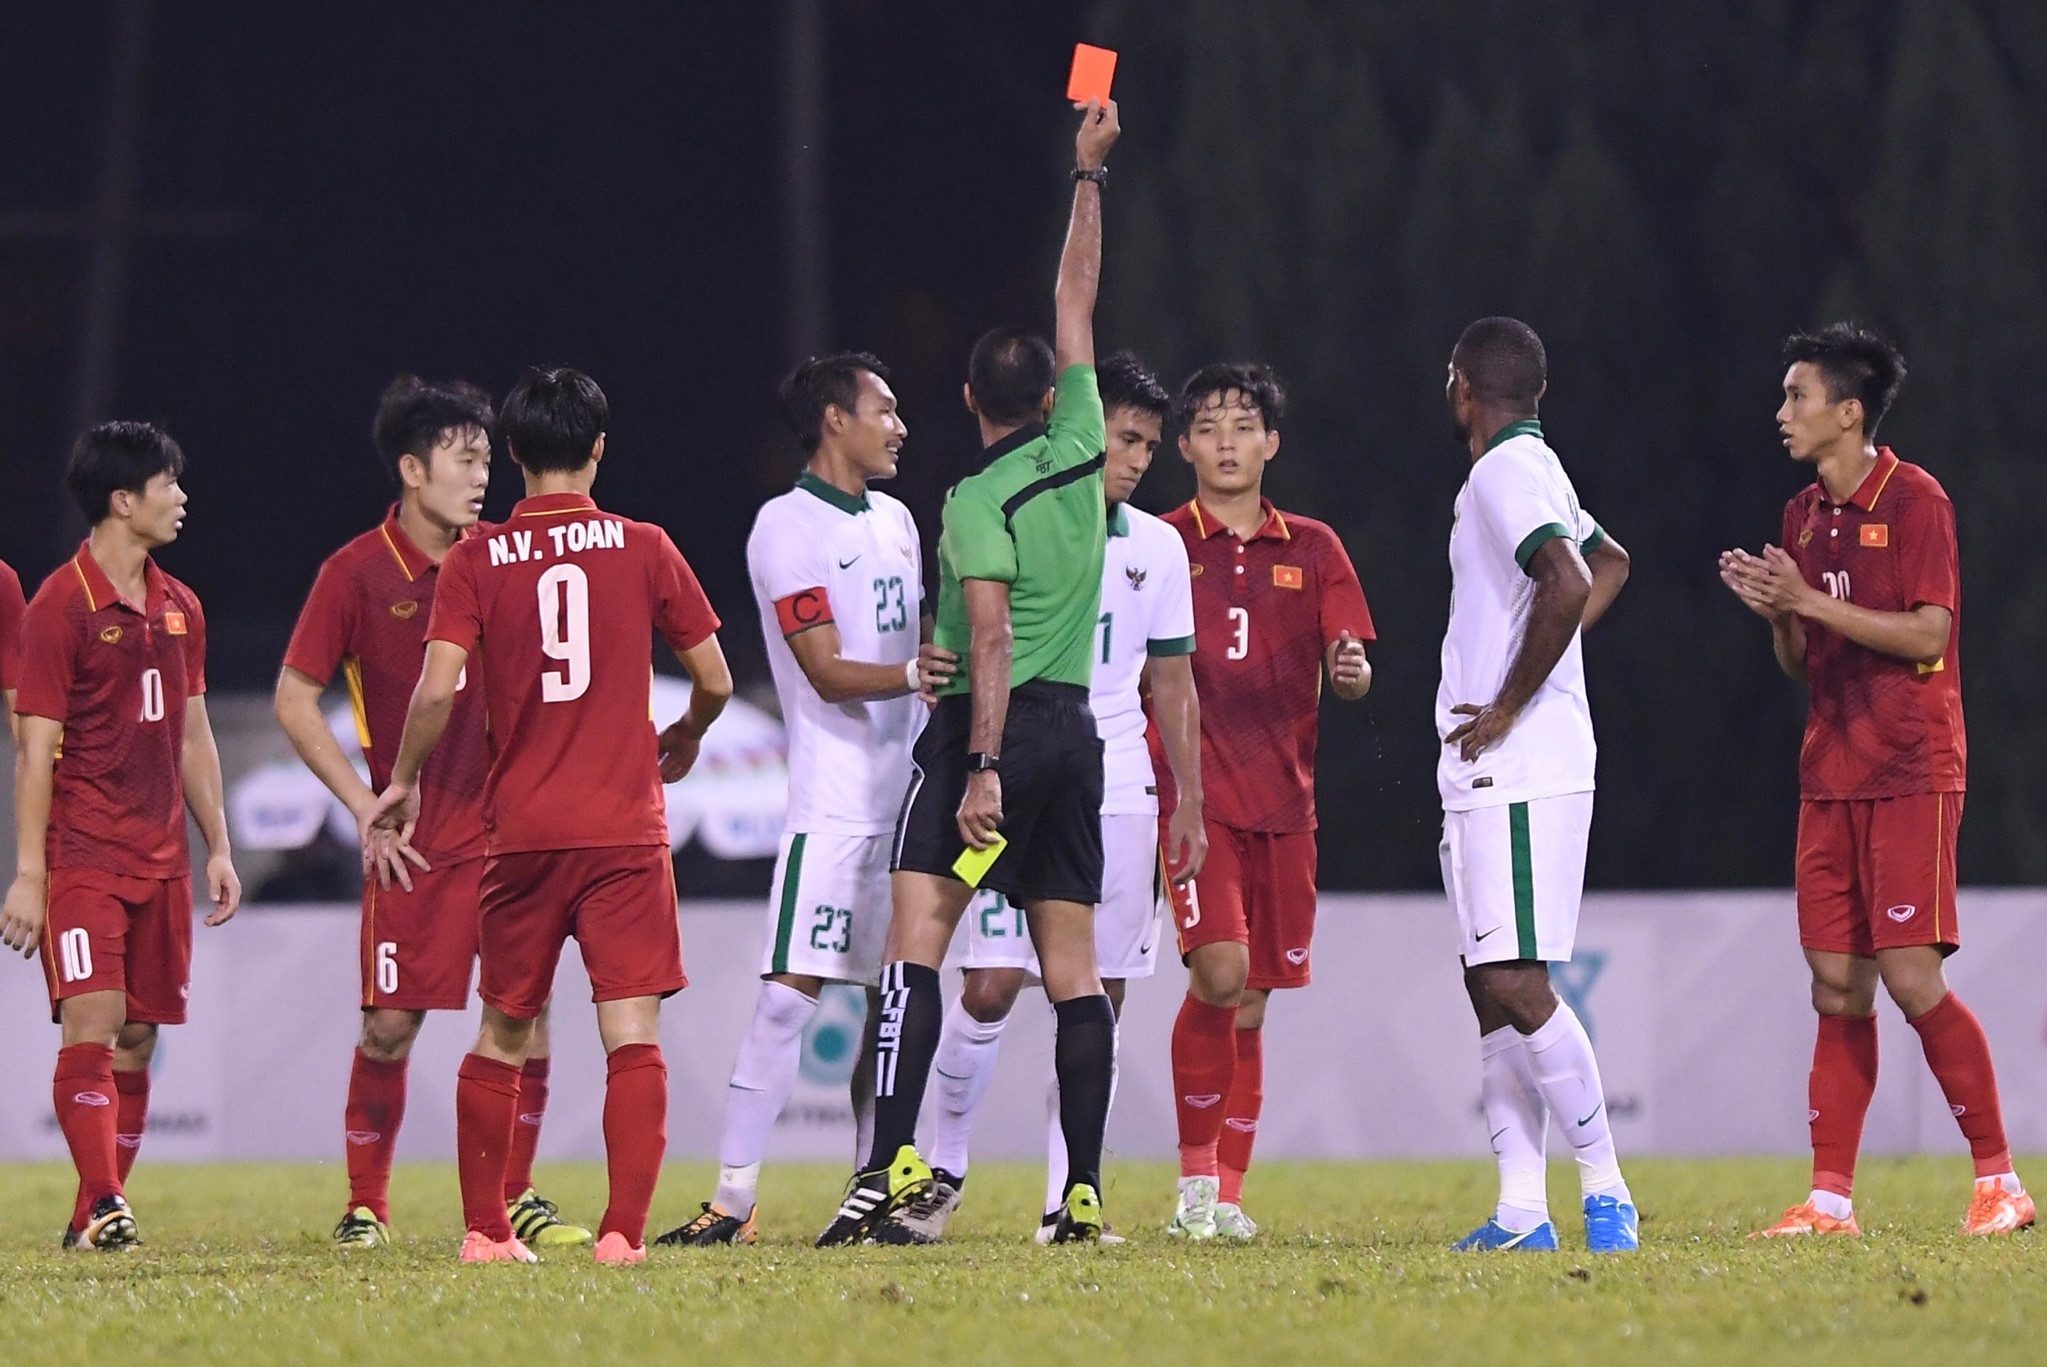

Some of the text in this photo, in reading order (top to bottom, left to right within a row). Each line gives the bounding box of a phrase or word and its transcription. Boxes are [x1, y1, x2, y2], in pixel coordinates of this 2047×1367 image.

[488, 520, 625, 566] N.V. TOAN
[792, 593, 822, 624] C
[873, 576, 907, 633] 23
[537, 563, 591, 703] 9
[1227, 607, 1249, 660] 3
[810, 904, 852, 953] 23
[980, 888, 1023, 937] 21
[1179, 878, 1201, 929] 3
[60, 927, 94, 983] 10
[377, 941, 399, 995] 6
[878, 1006, 905, 1053] FBT
